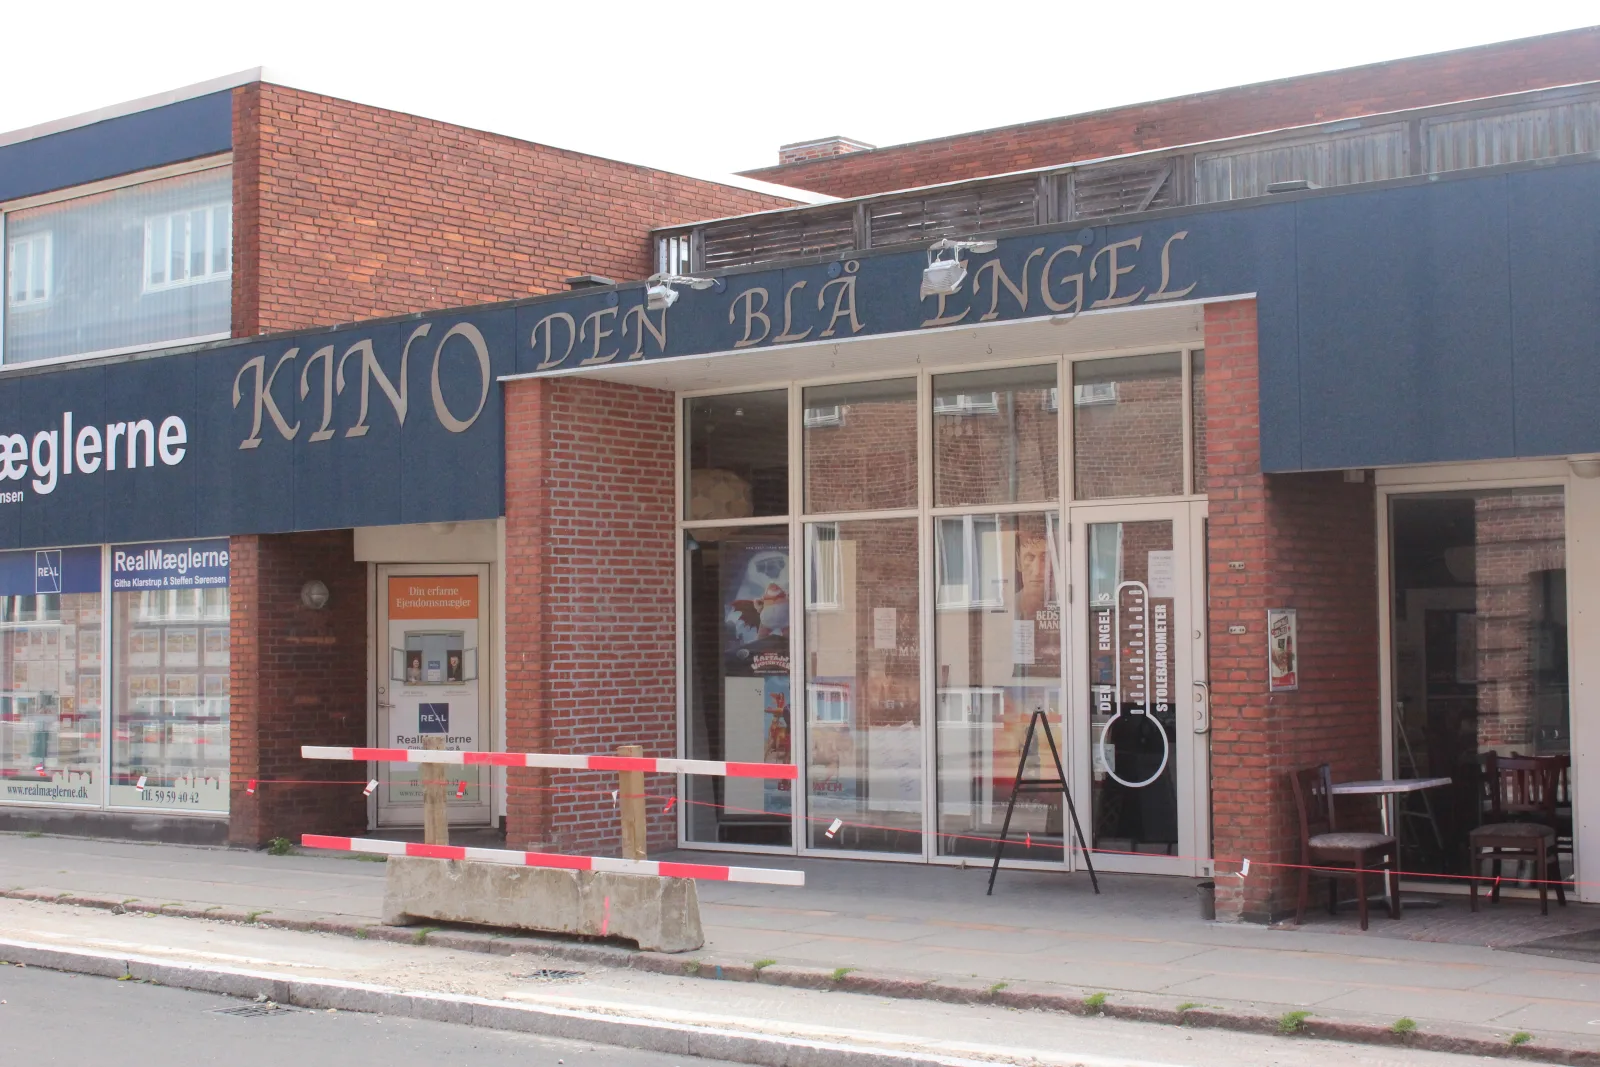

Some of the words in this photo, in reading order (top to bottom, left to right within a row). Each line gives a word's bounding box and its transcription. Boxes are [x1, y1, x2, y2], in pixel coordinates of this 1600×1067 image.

[530, 303, 667, 371] DEN
[729, 261, 866, 348] BLÅ
[919, 230, 1198, 326] ENGEL
[232, 322, 491, 450] KINO
[114, 547, 229, 574] RealMæglerne
[38, 567, 59, 577] REAL
[114, 579, 131, 588] Githa
[132, 577, 161, 588] Klarstrup
[169, 576, 193, 586] Steffen
[194, 575, 227, 585] Sørensen
[409, 586, 425, 596] Din
[427, 585, 459, 596] erfarne
[396, 598, 472, 609] Ejendomsmægler
[1155, 604, 1168, 712] STOLEBAROMETER
[1100, 685, 1112, 711] DEN
[420, 714, 447, 722] REAL
[396, 734, 472, 745] RealMlerne
[7, 784, 89, 800] www.realmæglerne.dk
